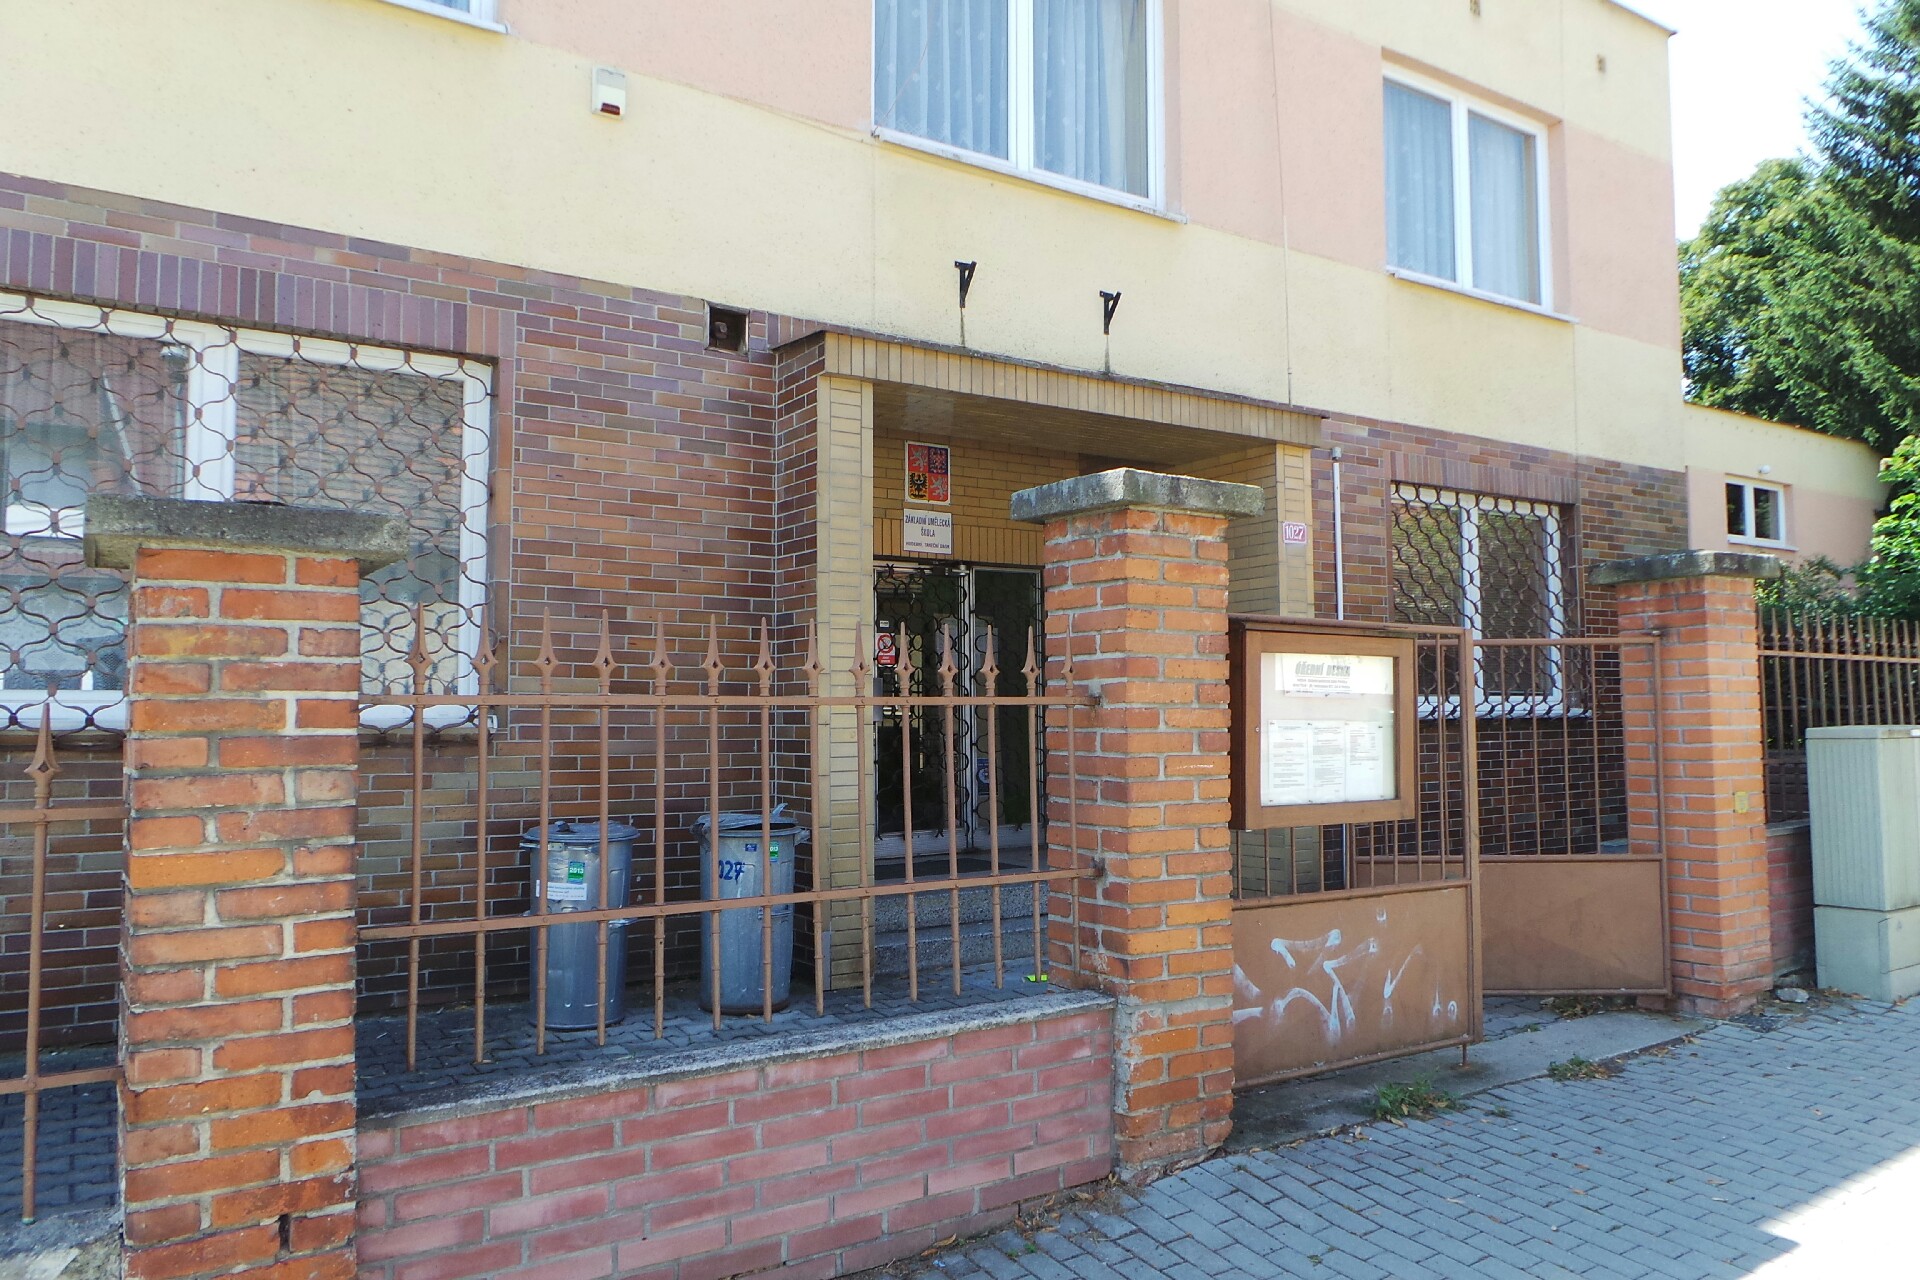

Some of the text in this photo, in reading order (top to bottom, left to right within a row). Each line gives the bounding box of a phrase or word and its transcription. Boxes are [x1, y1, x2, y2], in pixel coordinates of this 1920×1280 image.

[905, 514, 950, 528] ZÁKLADNÍ UMĚLECKÁ
[920, 526, 936, 537] ŠKOLA
[1284, 525, 1304, 540] 1027
[1295, 661, 1325, 676] ÚŘEDNÍ
